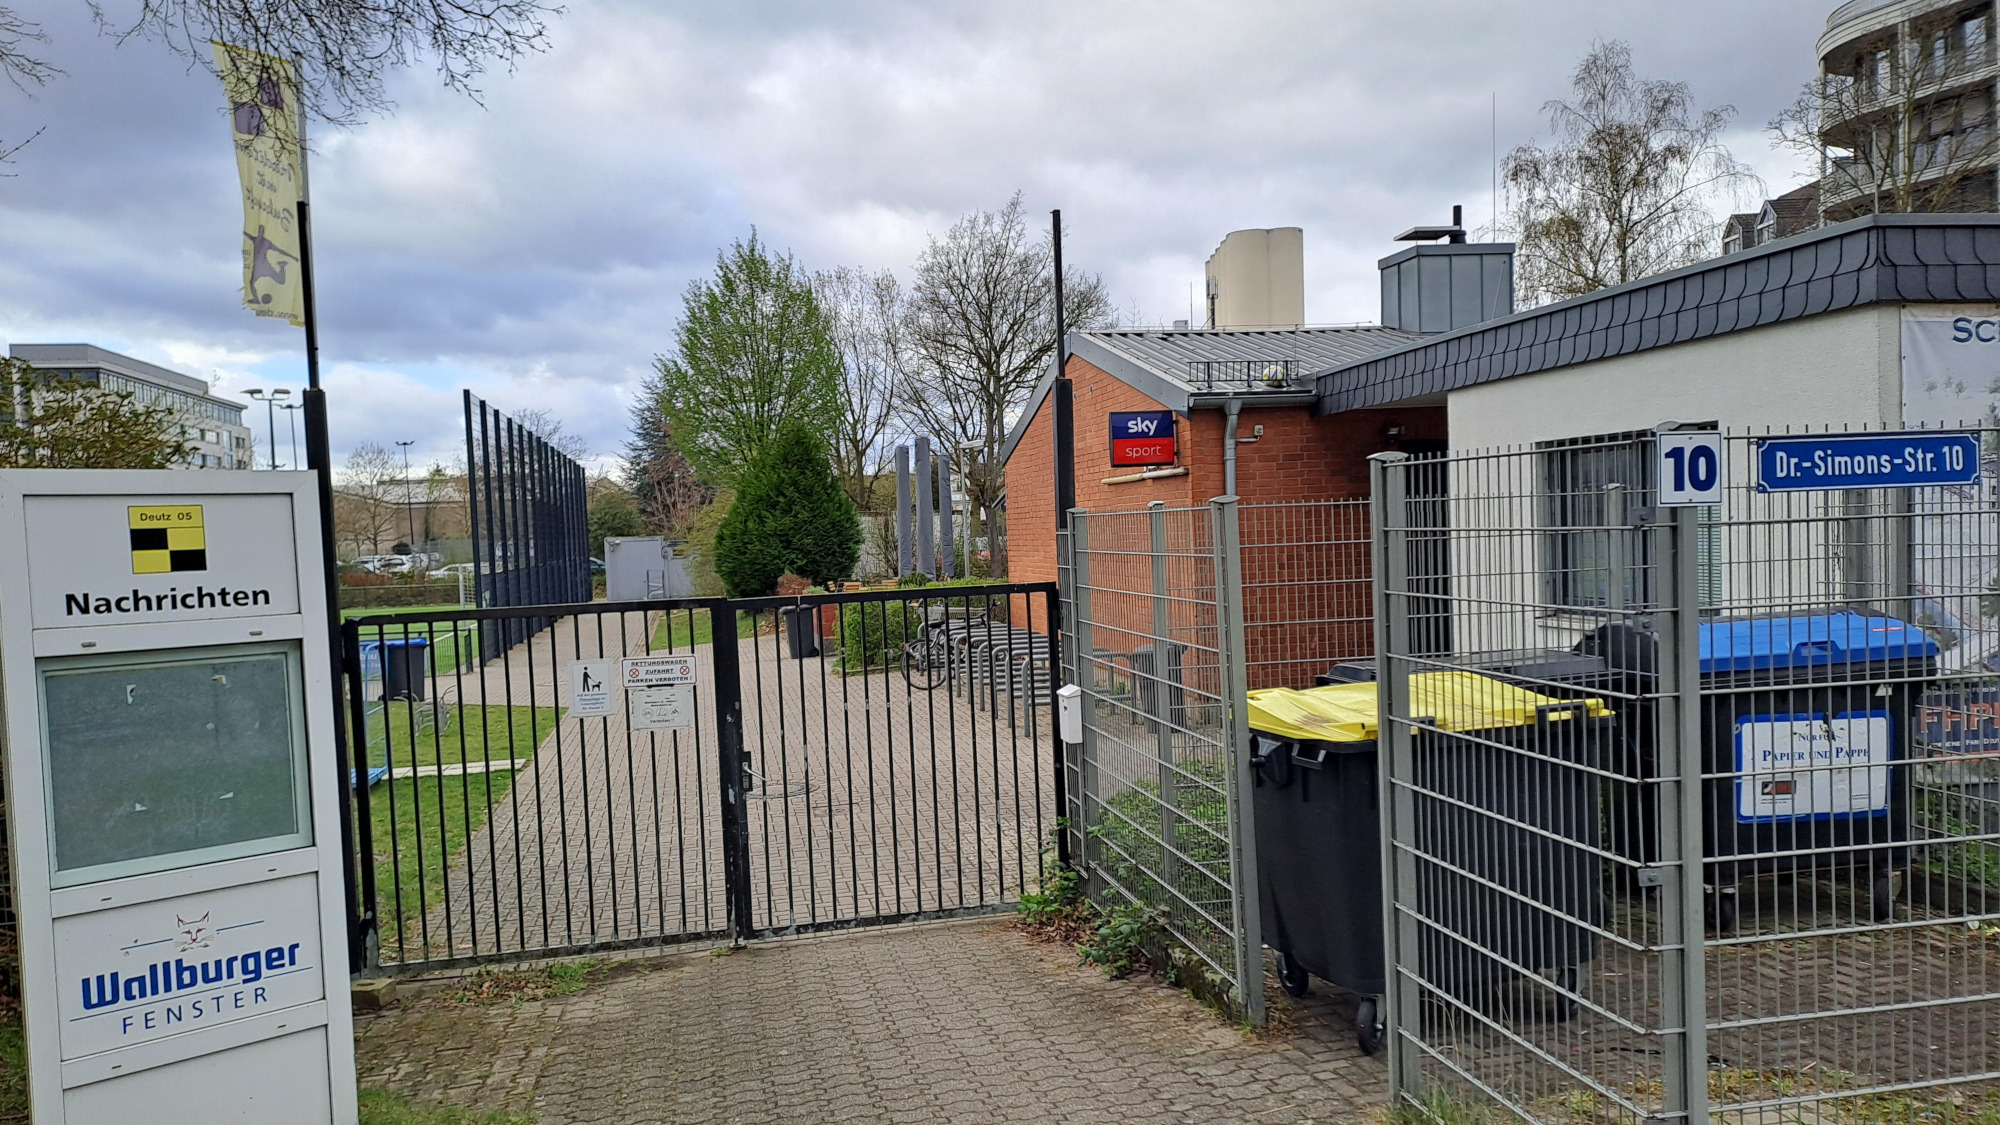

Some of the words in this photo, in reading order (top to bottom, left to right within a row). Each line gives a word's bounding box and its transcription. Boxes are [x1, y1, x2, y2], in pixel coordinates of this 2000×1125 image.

[1952, 316, 2000, 343] SC
[1127, 416, 1158, 436] sky
[1125, 445, 1162, 459] sport
[1775, 446, 1937, 478] Dr.-Simons-Str.
[1942, 445, 1964, 471] 10
[1664, 444, 1718, 492] 10
[140, 512, 172, 522] Deutz
[177, 512, 193, 521] 05
[65, 586, 271, 616] Nachrichten
[1762, 749, 1805, 761] PAPIER
[1808, 750, 1831, 760] UND
[81, 942, 300, 1010] Wallburger
[122, 986, 268, 1035] FENSTER
